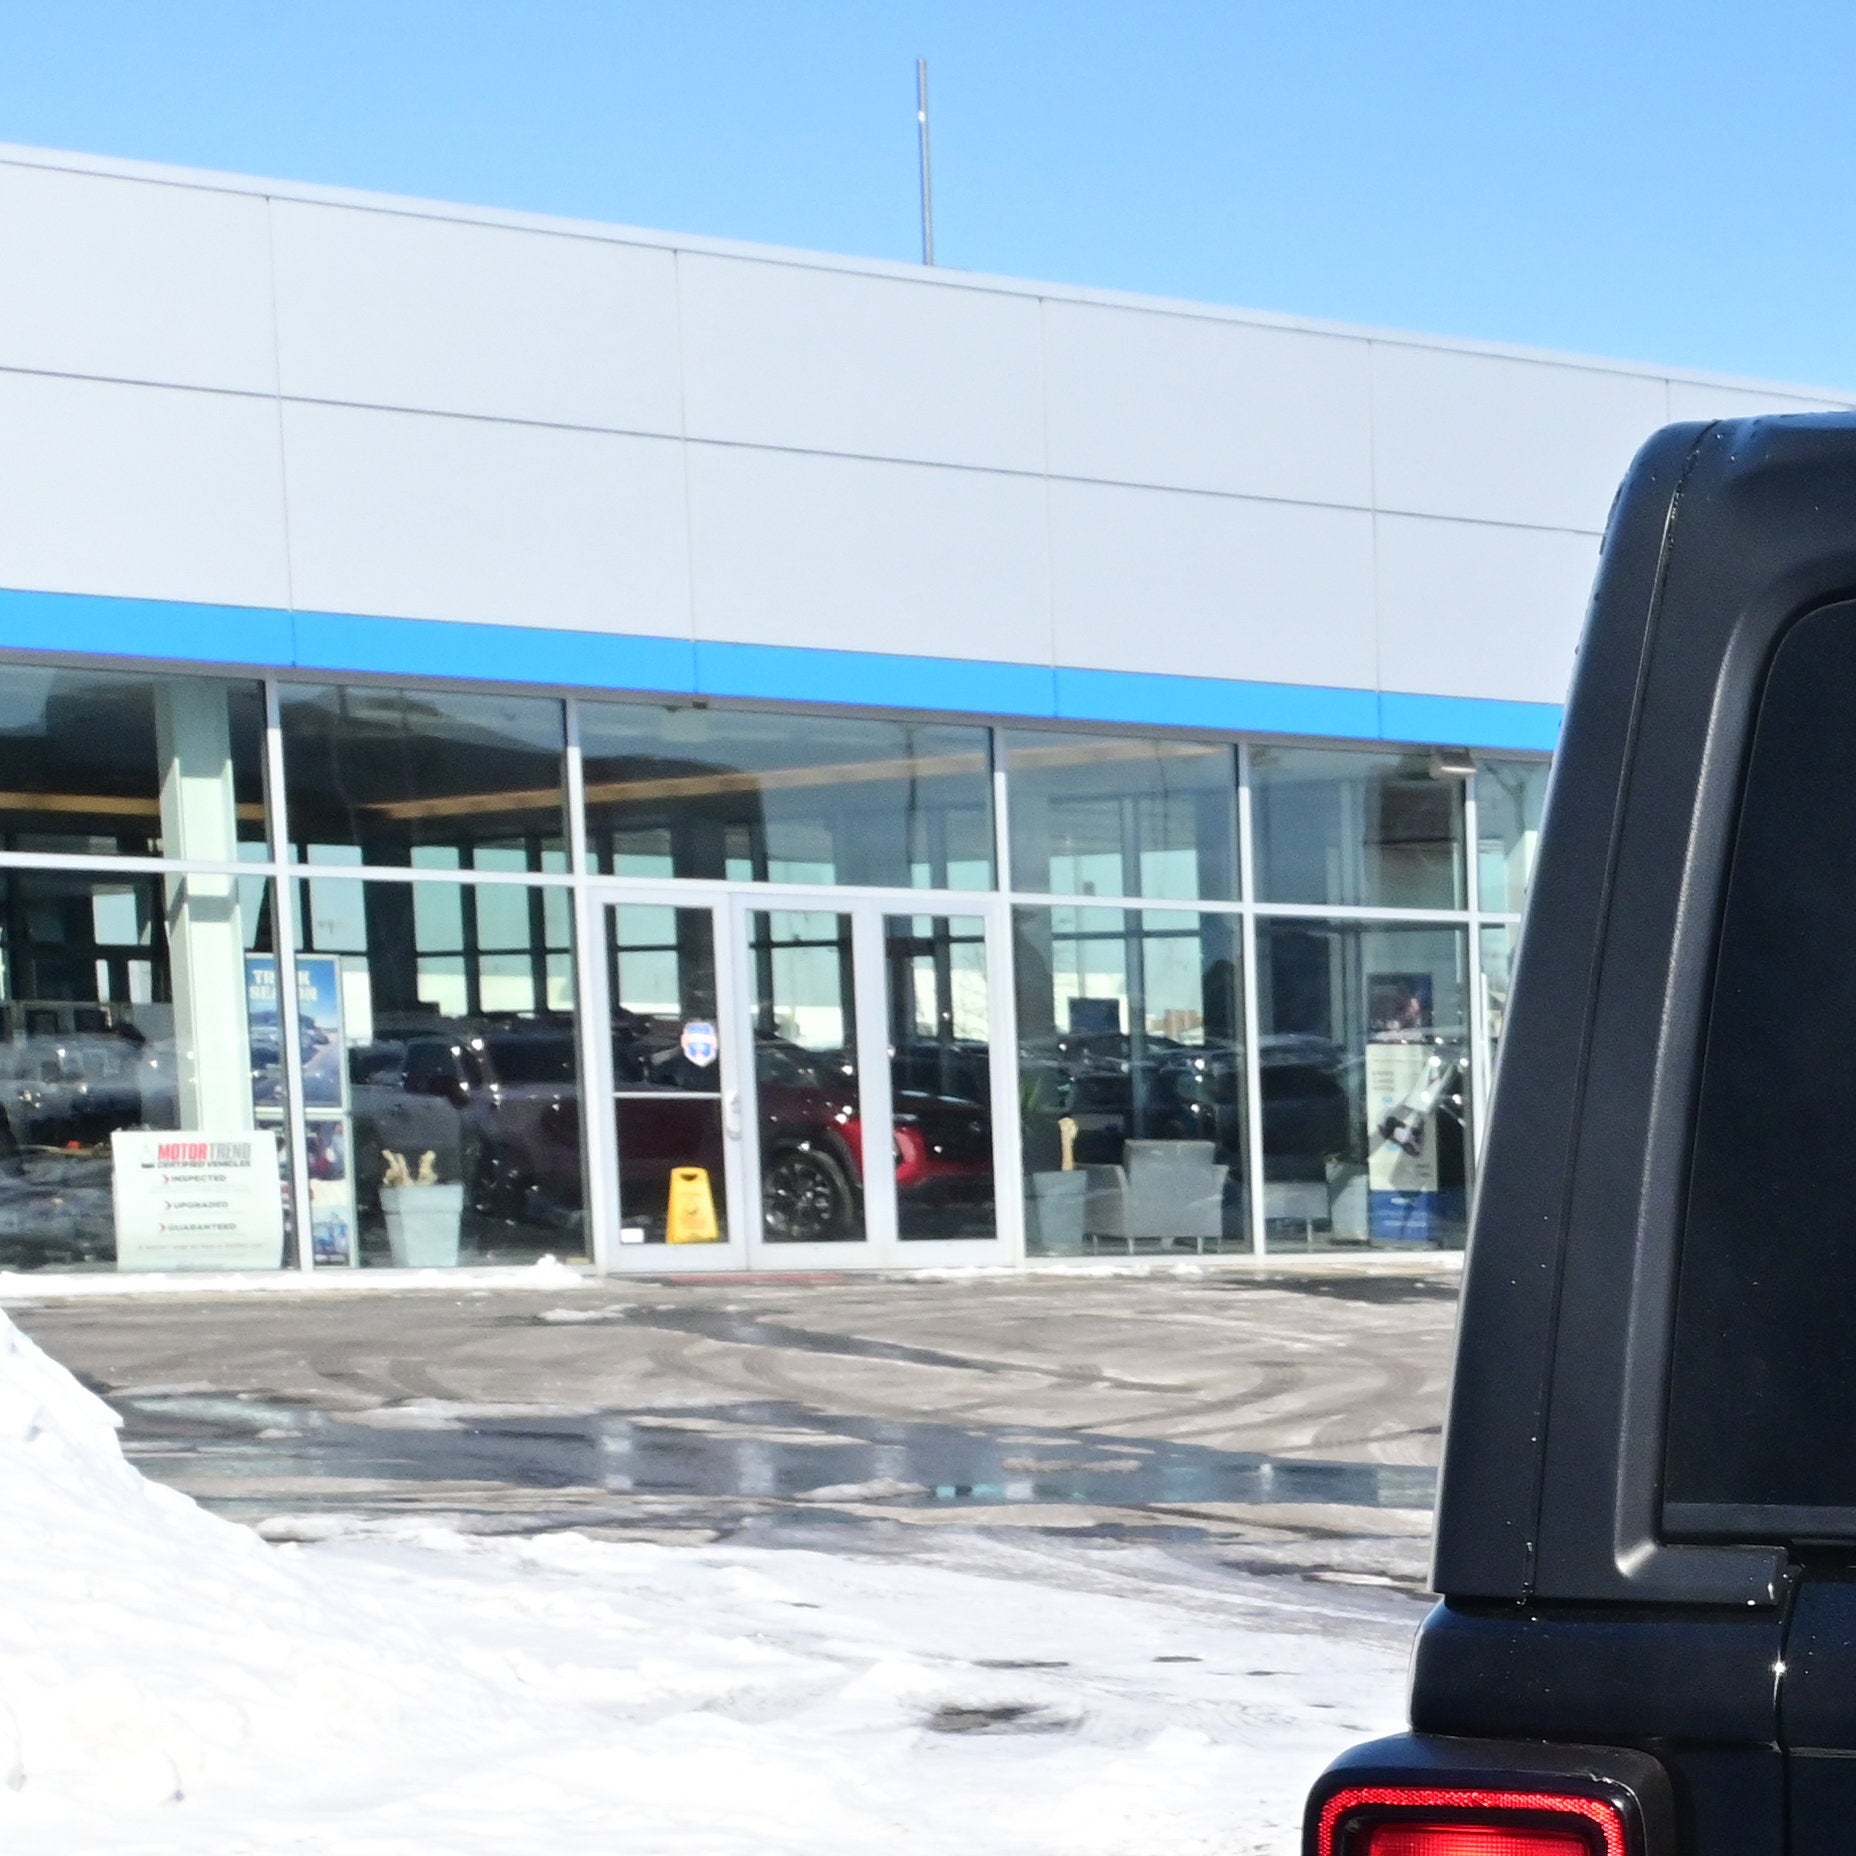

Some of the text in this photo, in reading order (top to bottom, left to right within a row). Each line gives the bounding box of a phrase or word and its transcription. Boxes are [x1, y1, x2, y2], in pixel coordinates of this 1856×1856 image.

[252, 969, 310, 985] TRK
[171, 1174, 227, 1183] INSPECTED
[173, 1201, 229, 1209] UPGRADED
[168, 1222, 238, 1231] GUARANTEED
